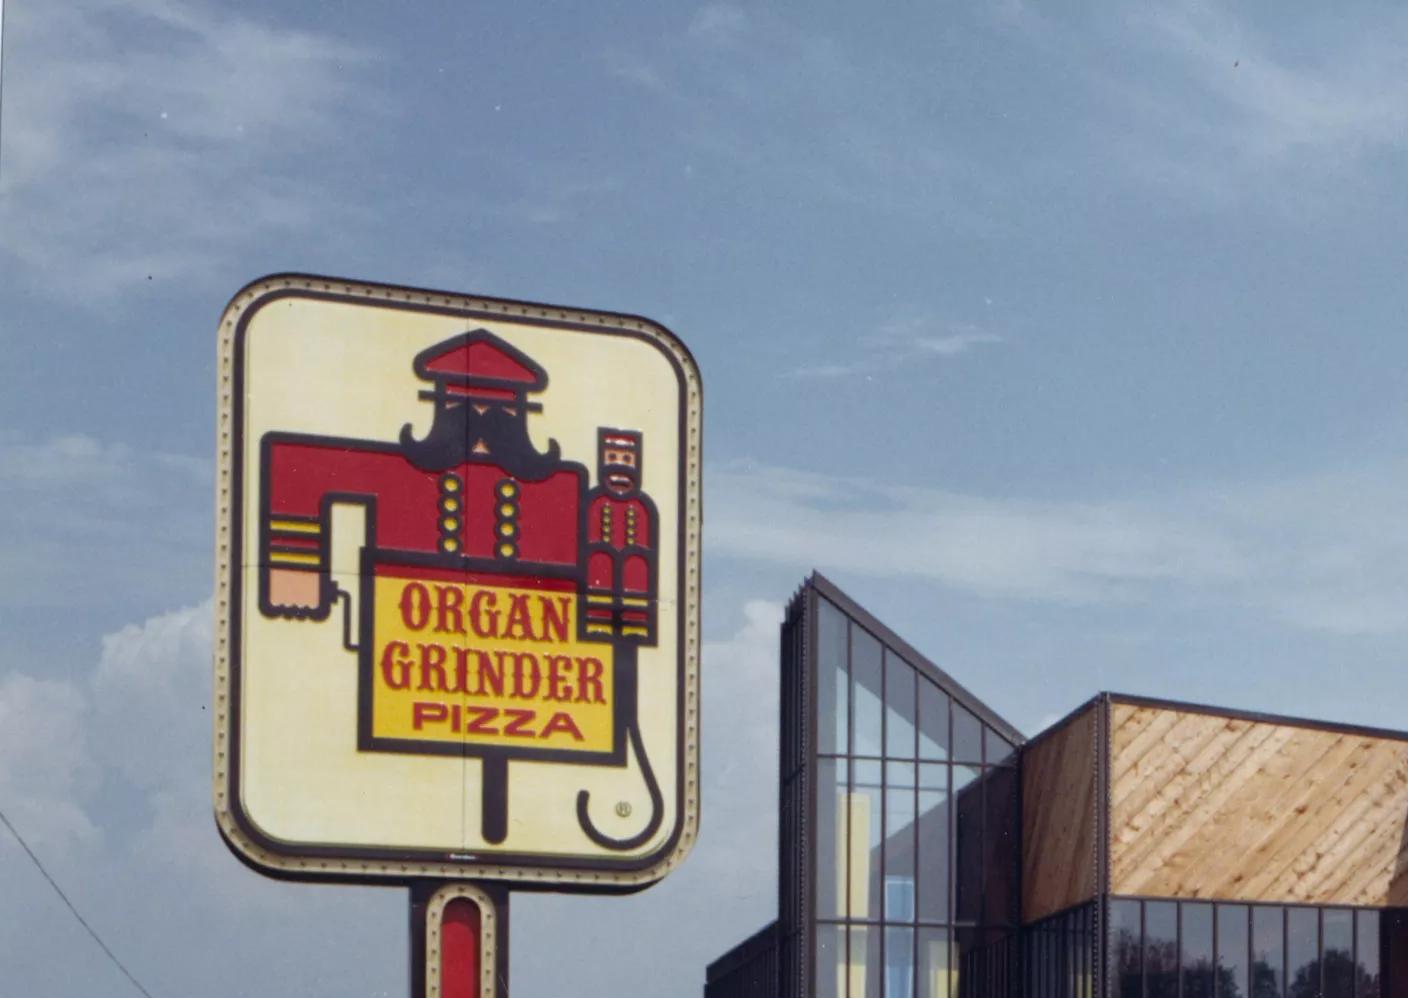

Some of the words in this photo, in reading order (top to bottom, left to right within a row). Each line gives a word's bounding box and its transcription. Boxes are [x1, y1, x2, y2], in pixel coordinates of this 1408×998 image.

[399, 581, 571, 643] ORGAN
[380, 640, 606, 704] GRINDER
[412, 701, 585, 742] PIZZA
